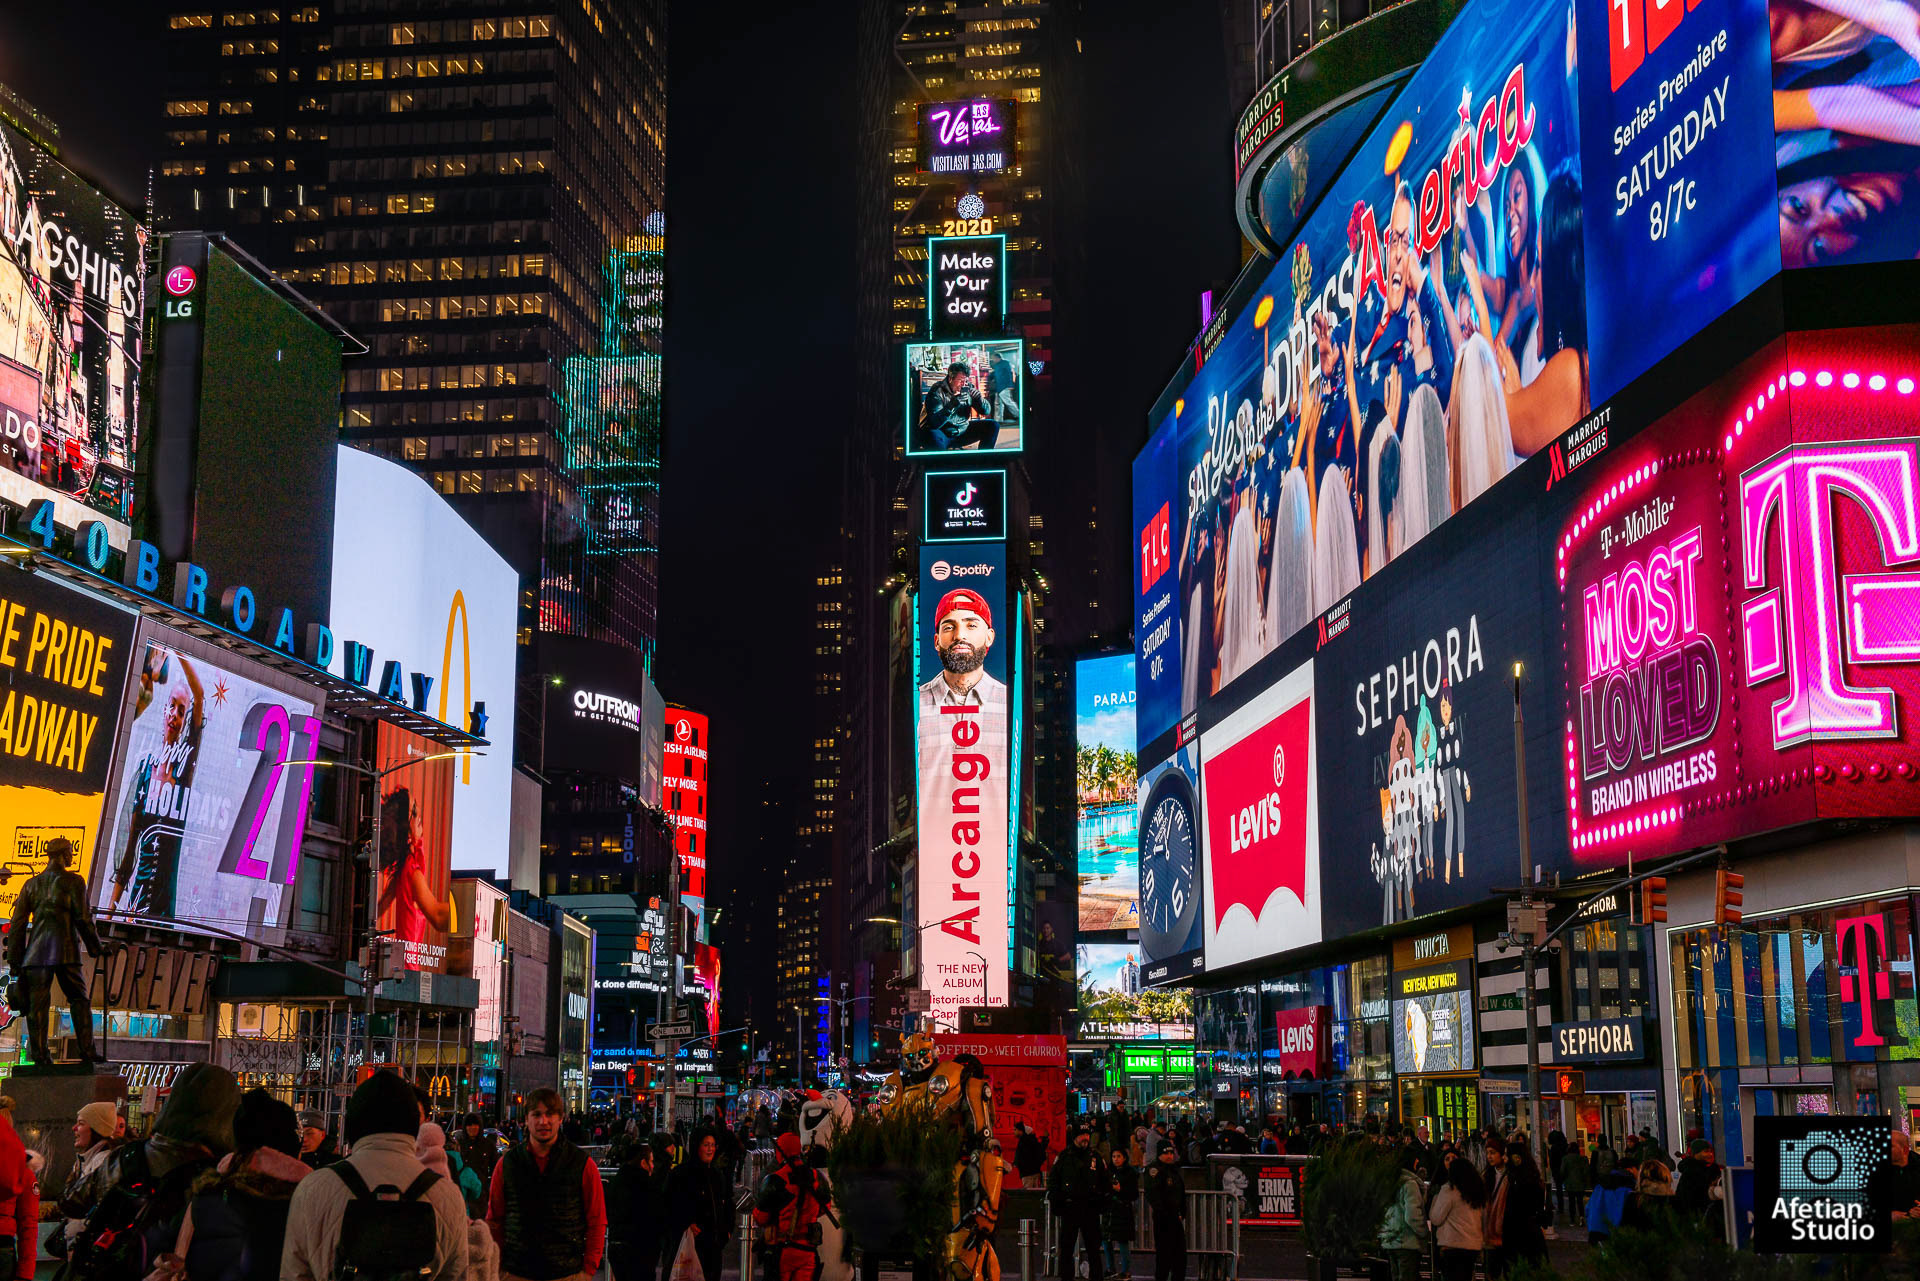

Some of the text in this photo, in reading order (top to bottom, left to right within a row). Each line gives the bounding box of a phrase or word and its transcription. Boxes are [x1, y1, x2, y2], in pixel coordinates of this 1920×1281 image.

[1614, 29, 1728, 155] Series Premiere
[1240, 75, 1289, 144] MARRIOTT
[1240, 108, 1281, 168] MARQUIS
[1615, 75, 1730, 216] SATURDAY
[932, 153, 1002, 172] VISITLASVGAS.COM
[1358, 62, 1537, 304] Aerica
[1649, 177, 1697, 241] 8/7c
[943, 218, 992, 237] 2020
[940, 252, 994, 271] Make
[944, 275, 989, 297] your
[166, 301, 192, 317] LG
[947, 298, 987, 317] day.
[1567, 407, 1612, 450] MARRIOTT
[1567, 431, 1608, 469] MARQUIS
[1188, 451, 1211, 520] SAY
[947, 508, 984, 518] TikTok
[1141, 522, 1169, 578] TLC
[952, 564, 995, 577] Spotify
[1142, 592, 1171, 628] Series Premiere
[1328, 599, 1352, 624] MARRIOTT
[1583, 526, 1702, 684] MOST
[125, 539, 434, 712] BROADWAY
[1327, 616, 1350, 641] MARQUIS
[1142, 616, 1172, 660] SATURDAY
[26, 612, 113, 697] PRIDE
[1356, 614, 1484, 736] SEPHORA
[1094, 691, 1136, 707] PARAD
[1579, 632, 1721, 781] LOVED
[574, 710, 586, 718] WE
[590, 713, 604, 721] GET
[684, 746, 708, 761] AIRLINES
[663, 776, 698, 791] FLY MORE
[1590, 750, 1718, 816] BRAND IN WIRELESS
[940, 704, 991, 944] Arcangel
[17, 841, 33, 857] THE
[1578, 895, 1617, 917] SEPHORA
[1414, 933, 1450, 961] INVICTA
[405, 953, 417, 964] SHE
[417, 956, 433, 966] FOUND
[937, 964, 989, 974] THE NEW
[602, 980, 625, 988] done
[943, 979, 983, 988] ALBUM
[1403, 978, 1414, 994] NEW
[1440, 972, 1457, 988] WATCH
[969, 994, 985, 1004] de
[989, 996, 1002, 1004] un
[1490, 1000, 1498, 1009] W
[1502, 1000, 1514, 1009] 46
[931, 1009, 957, 1019] Capr
[1080, 1022, 1150, 1032] ATLANTIS
[936, 1045, 988, 1056] OFFEED
[994, 1045, 1021, 1056] SWEET
[1023, 1045, 1061, 1056] CHURROS
[1560, 1024, 1633, 1056] SEPHORA
[603, 1047, 626, 1056] sand
[1127, 1057, 1158, 1067] LINE
[120, 1064, 170, 1088] FOREVER
[607, 1061, 632, 1072] Dieg
[1258, 1179, 1294, 1196] ERIKA
[1259, 1197, 1295, 1213] JAYNE
